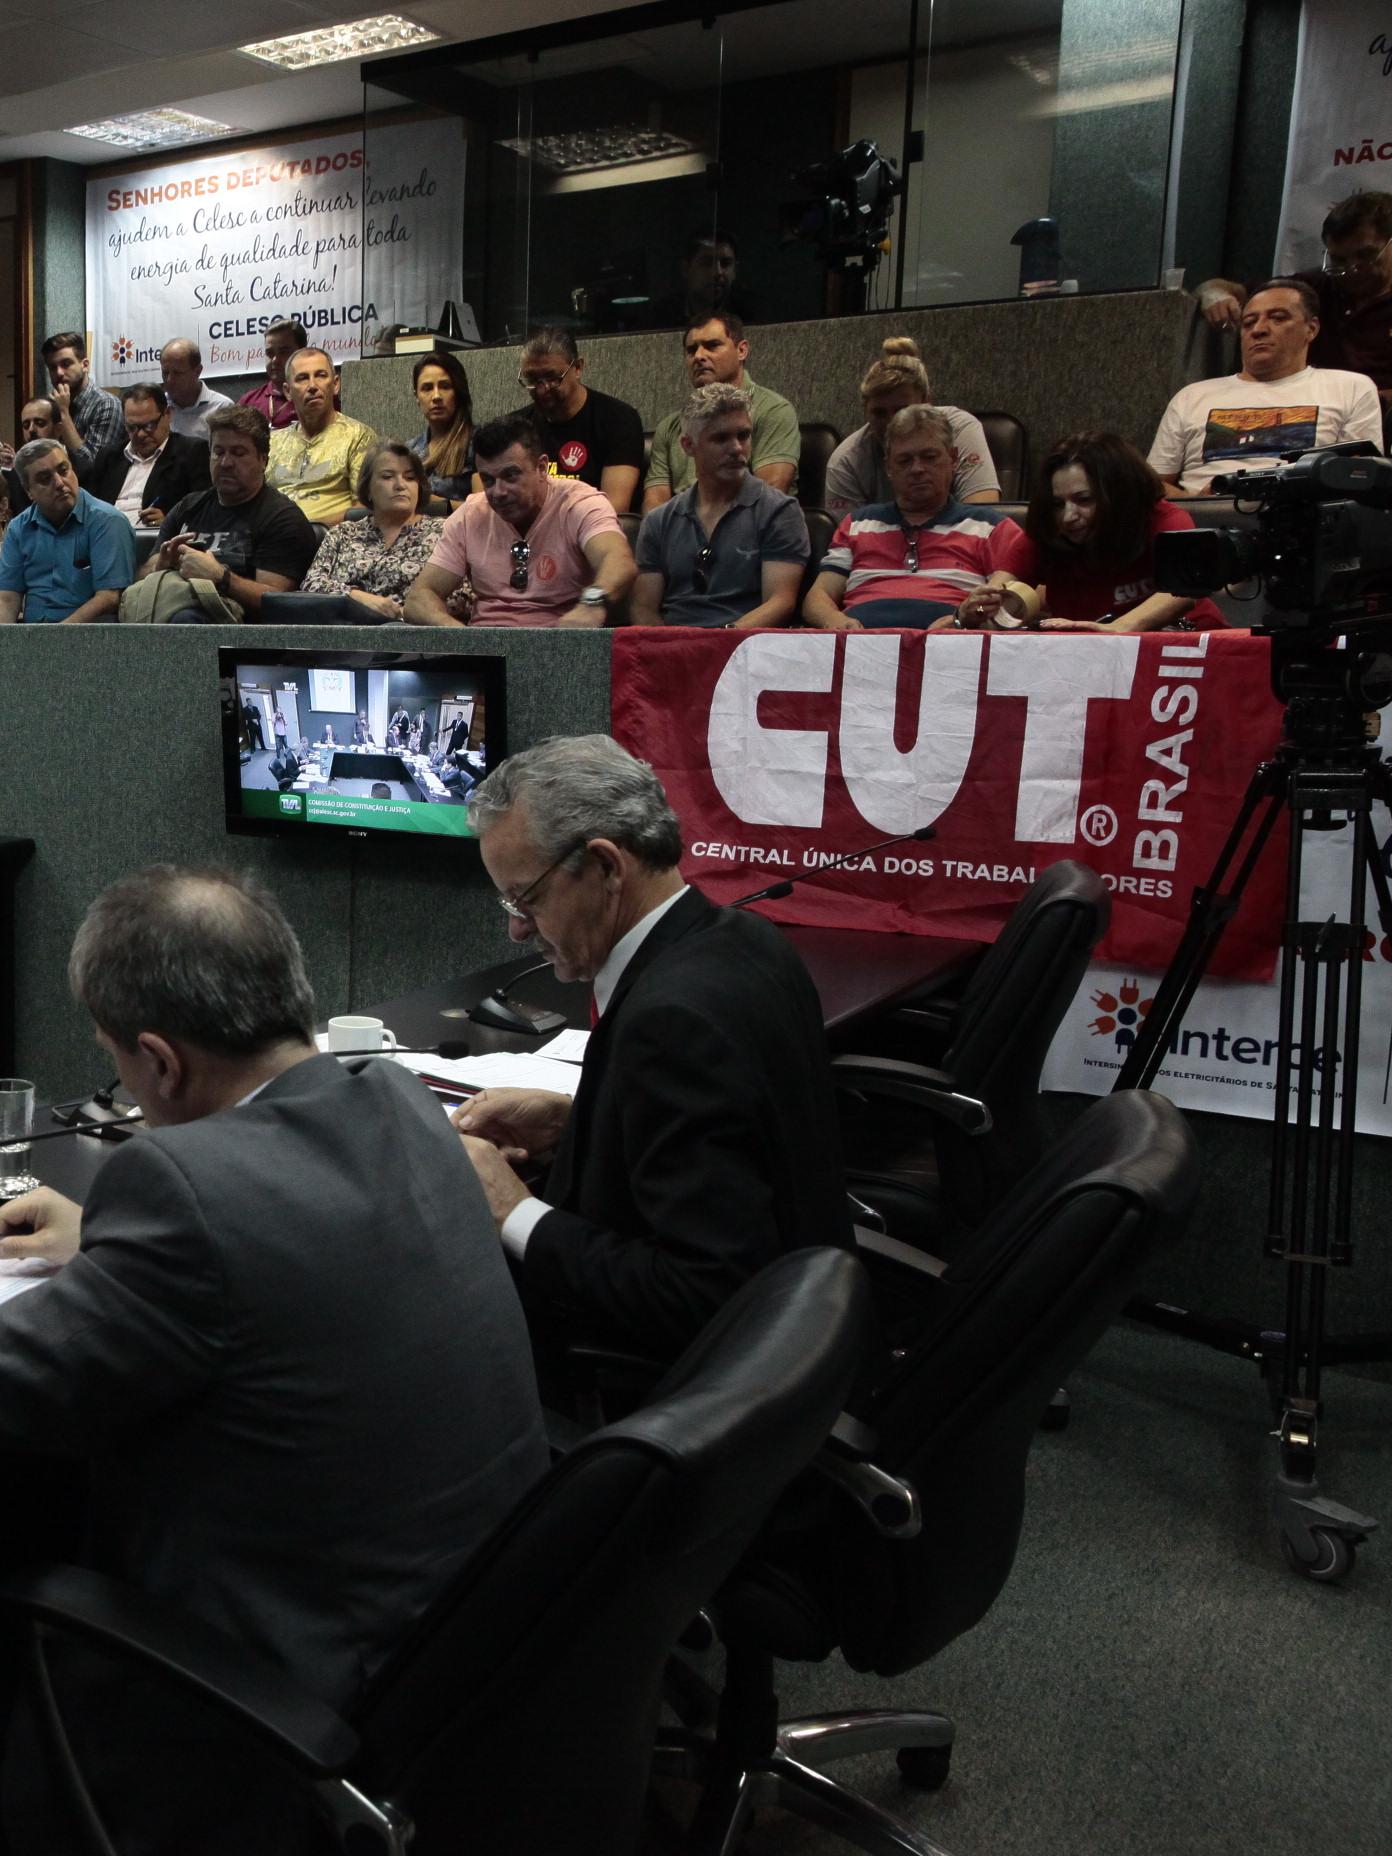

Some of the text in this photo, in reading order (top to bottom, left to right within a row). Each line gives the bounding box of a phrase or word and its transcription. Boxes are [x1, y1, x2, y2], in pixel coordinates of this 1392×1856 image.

[107, 175, 219, 212] SENHORES
[108, 216, 172, 258] ajudem
[176, 222, 188, 236] a
[193, 203, 247, 234] Celesc
[250, 208, 262, 222] a
[266, 189, 358, 221] continuar
[130, 213, 412, 286] energia de qualidade para toda
[191, 264, 338, 310] Santa Catarina!
[135, 347, 162, 363] Inte
[210, 344, 245, 364] Bom
[706, 632, 1142, 845] CUT
[1131, 633, 1211, 873] BRASIL
[308, 799, 336, 808] COMISSÃO
[344, 801, 384, 812] CONSTITUIÇÃO
[389, 806, 411, 815] JUSTIÇA
[691, 841, 796, 866] CENTRAL
[802, 847, 878, 873] ÚNICA
[883, 856, 934, 877] DOS
[1173, 1071, 1248, 1087] ELETRICITÁRIOS
[1250, 1081, 1263, 1089] DE
